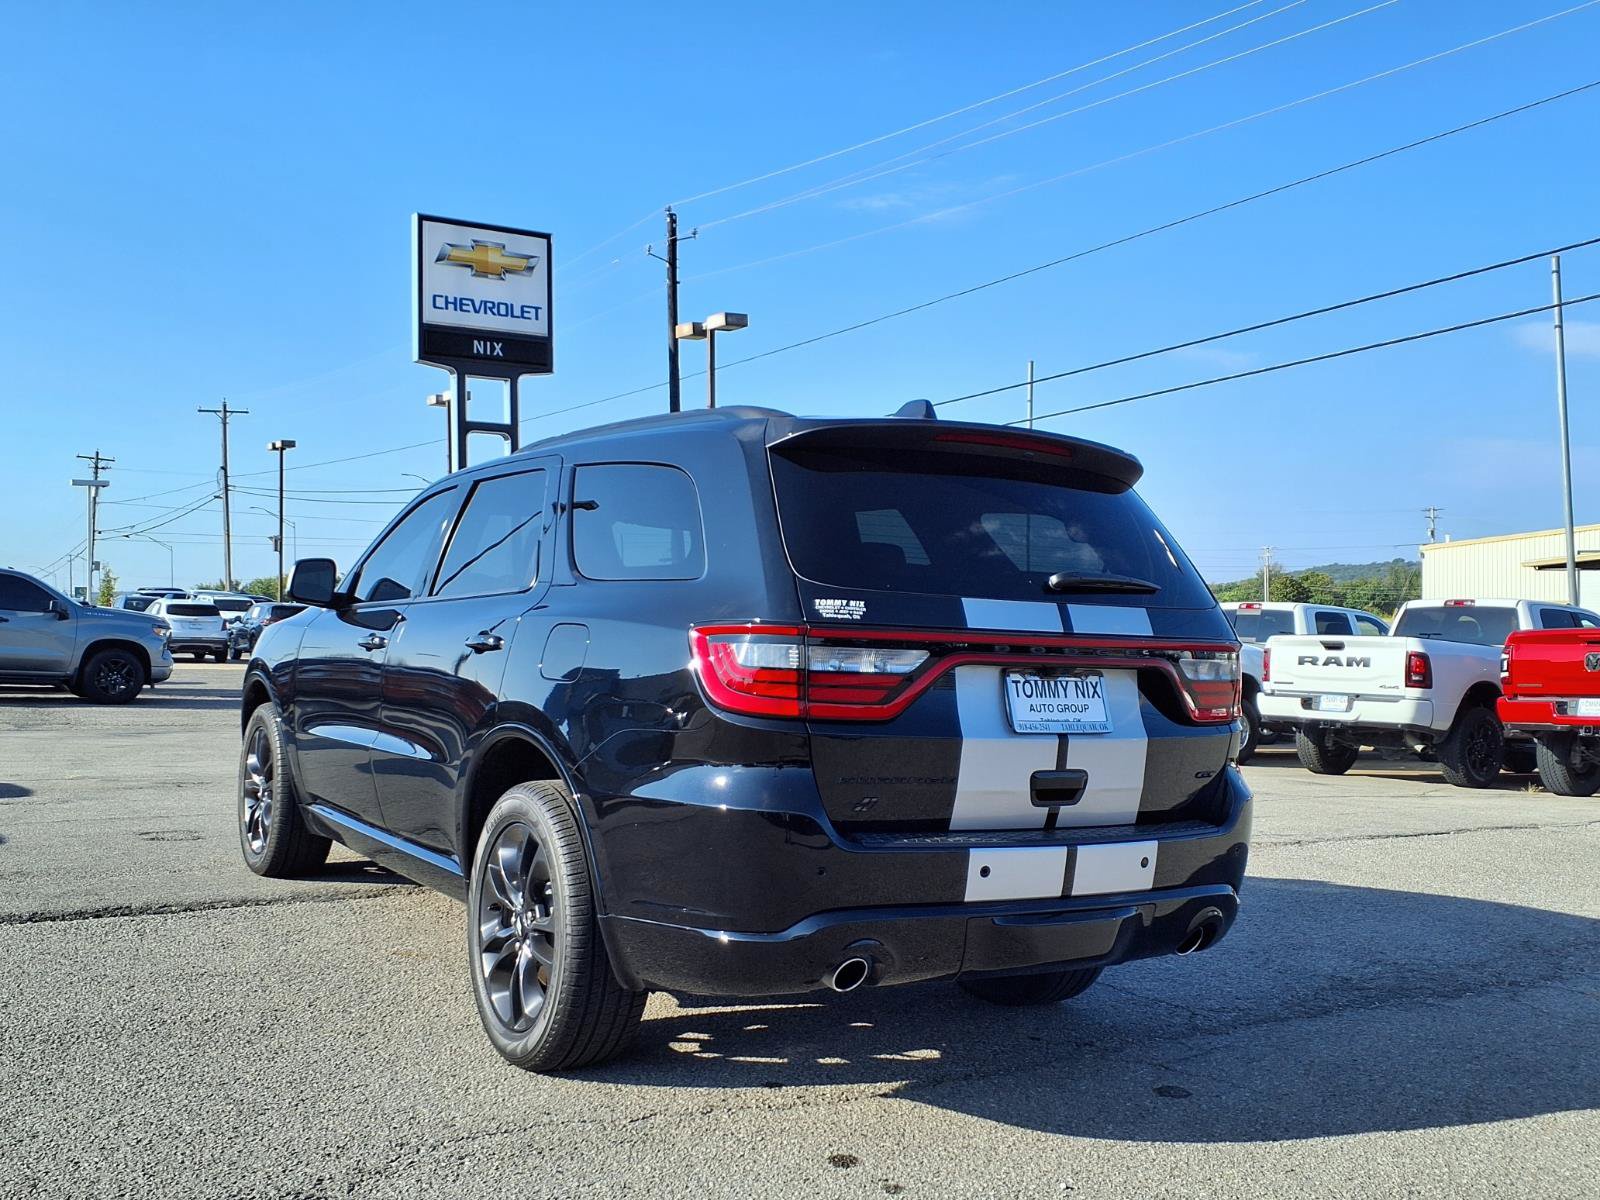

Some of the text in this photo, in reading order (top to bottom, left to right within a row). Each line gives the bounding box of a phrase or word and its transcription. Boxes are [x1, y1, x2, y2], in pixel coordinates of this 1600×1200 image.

[432, 294, 543, 321] CHEVROLET
[473, 340, 504, 357] NIX
[1298, 655, 1371, 668] RAM
[1011, 680, 1102, 699] TOMMY NIX
[1029, 703, 1090, 713] AUTO GROUP
